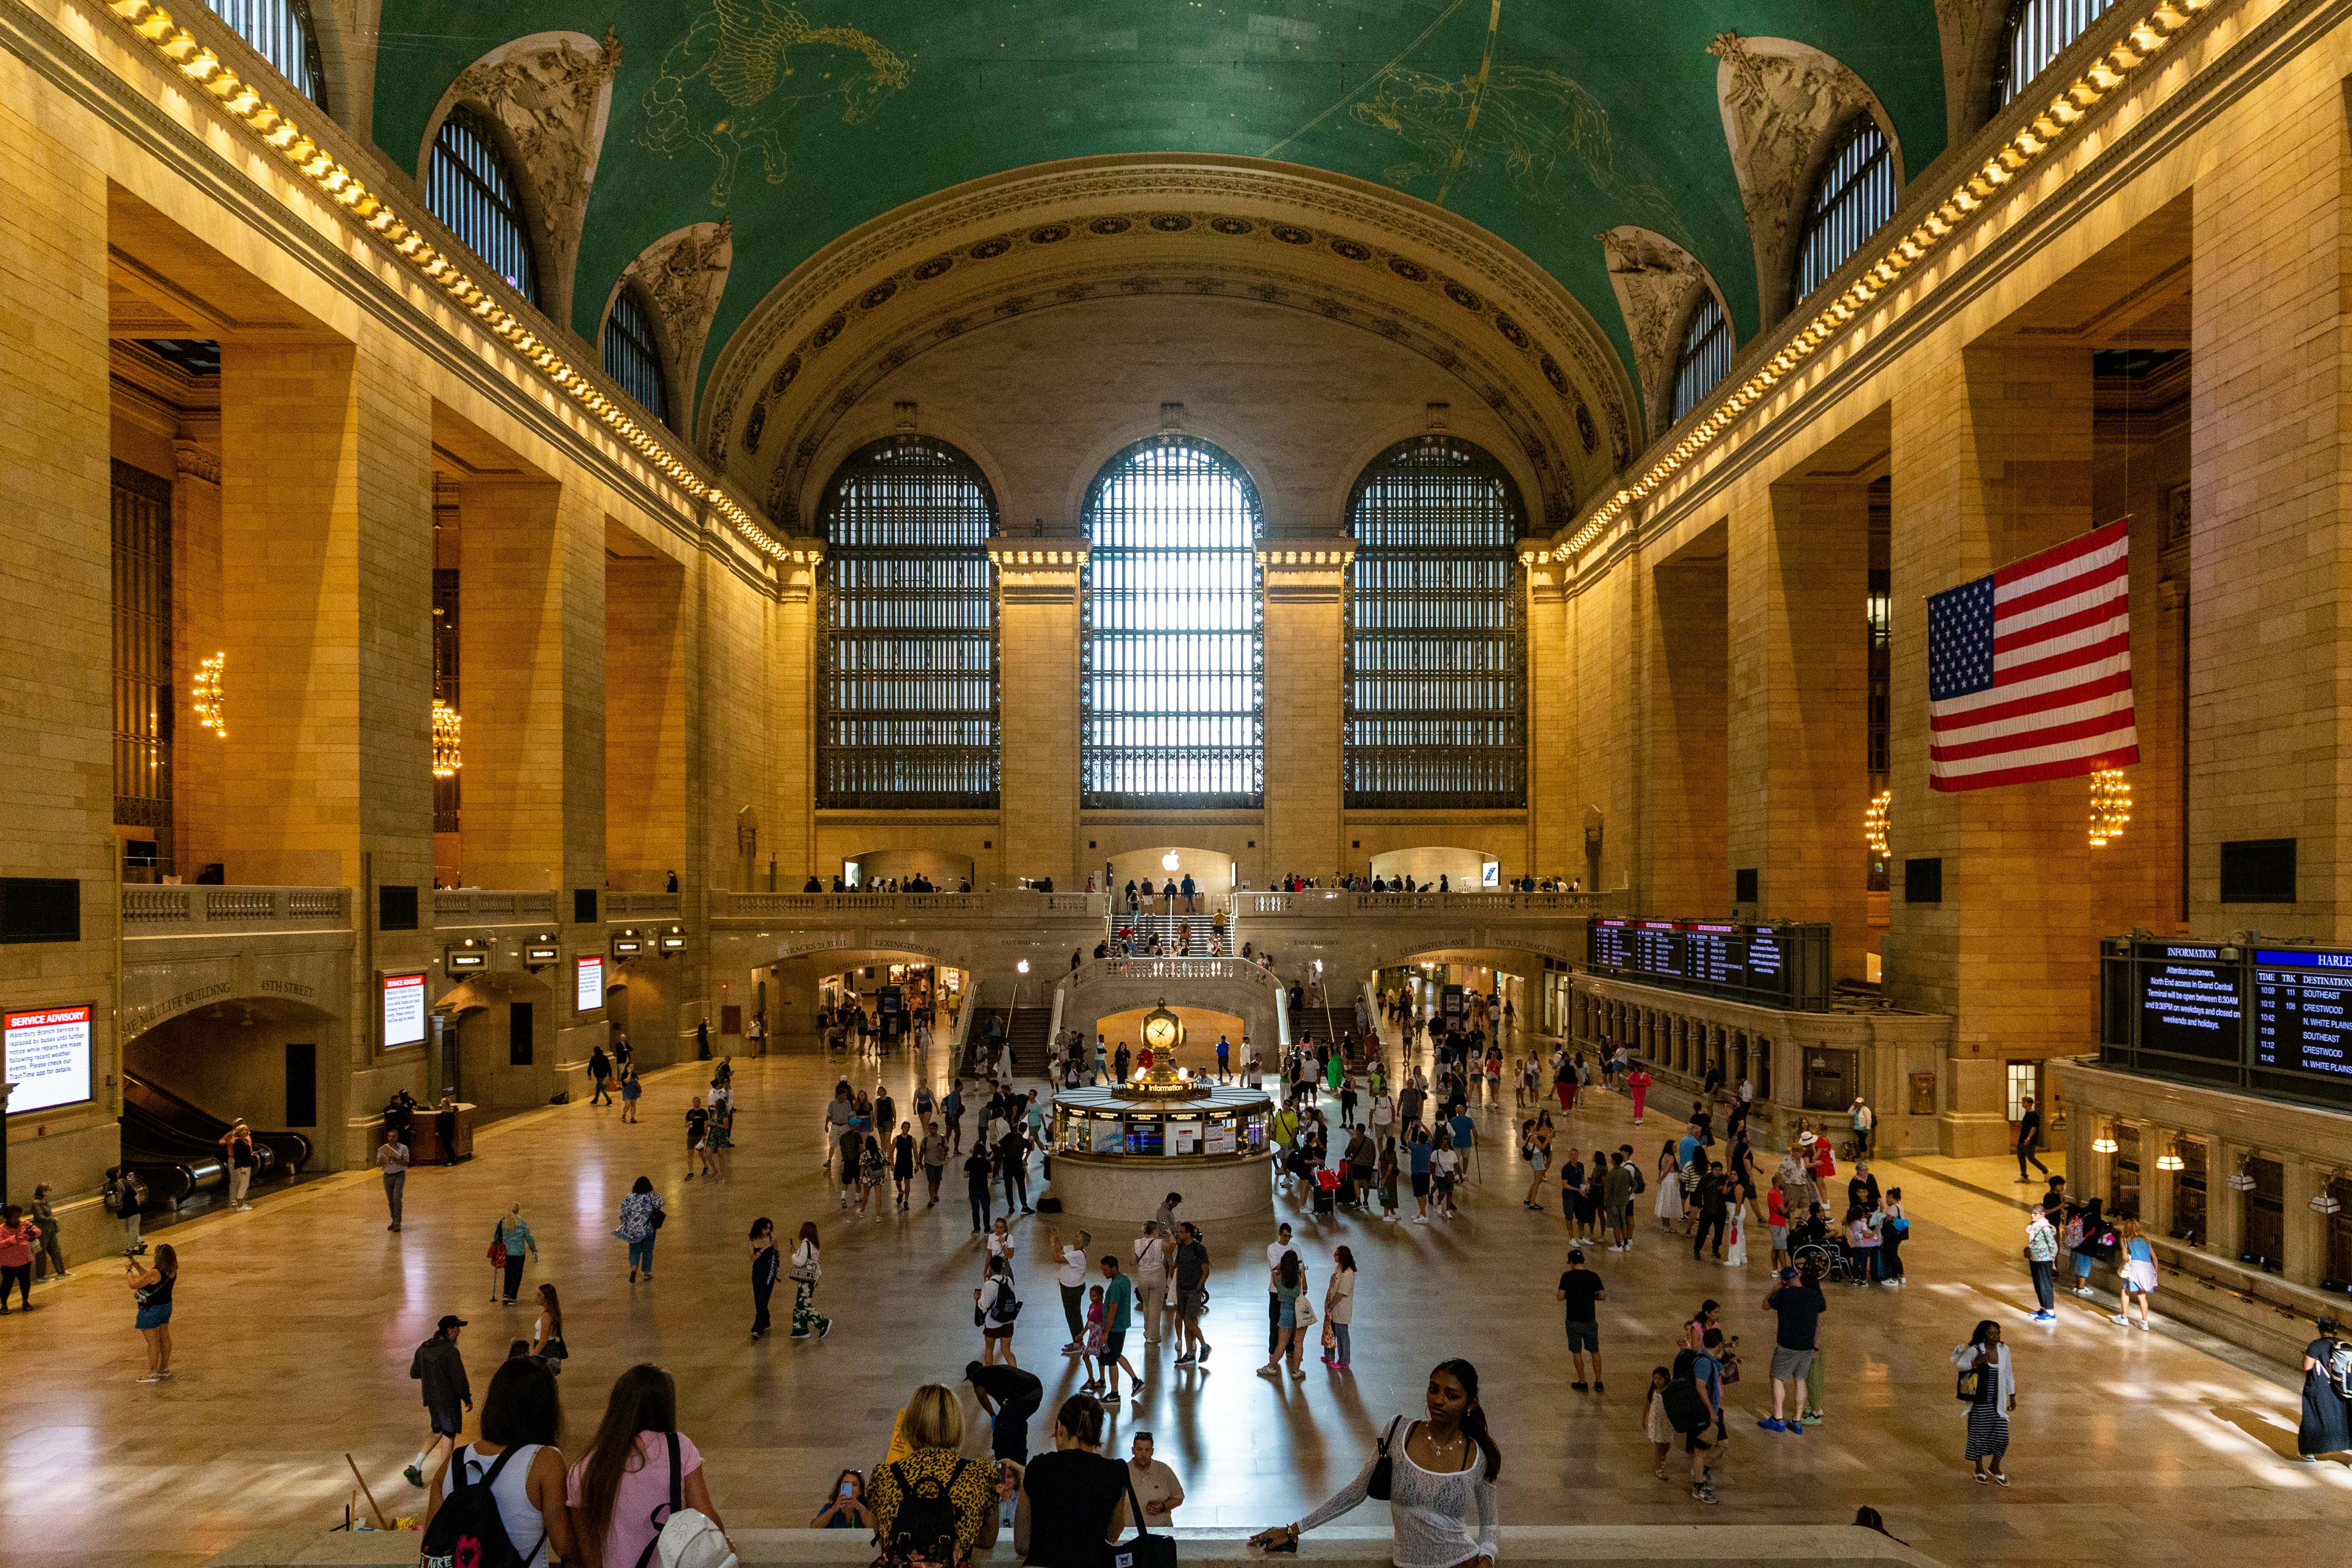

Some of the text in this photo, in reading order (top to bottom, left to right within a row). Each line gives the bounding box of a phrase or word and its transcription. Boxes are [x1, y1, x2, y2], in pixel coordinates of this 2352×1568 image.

[785, 943, 816, 955] TRACKS
[875, 940, 942, 955] LEXINGTON AVE
[1400, 941, 1448, 955] LEXINGTON
[1495, 939, 1567, 956] TICKET MACHINES
[2167, 947, 2216, 958] INFORMATION
[2166, 966, 2215, 978] Attention customers,
[2150, 977, 2164, 985] North
[2198, 981, 2213, 989] Grand
[2214, 982, 2233, 991] Central
[2259, 973, 2352, 987] TIME TRK DESTINATION
[284, 981, 314, 998] STREET
[2147, 989, 2167, 998] Terminal
[2196, 994, 2217, 1002] between
[2218, 995, 2238, 1004] 6:30AM
[2303, 990, 2340, 1000] SOUTHEAST
[139, 995, 184, 1026] METLIFE
[184, 982, 230, 1005] BUILDING
[2155, 1002, 2172, 1010] 9:30PM
[2180, 1005, 2204, 1015] weekdays
[2216, 1009, 2233, 1017] closed
[2260, 1000, 2275, 1008] 10:12
[2303, 1004, 2343, 1014] CRESTWOOD
[11, 1011, 84, 1027] SERVICE ADVISORY
[2162, 1016, 2187, 1025] weekends
[2198, 1019, 2220, 1029] holidays.
[2311, 1019, 2330, 1027] WHITE
[2331, 1021, 2352, 1030] PLAINS
[2303, 1032, 2340, 1043] SOUTHEAST
[2260, 1041, 2343, 1058] 11:12 CRESTWOOD
[2260, 1054, 2274, 1063] 11:42
[2310, 1060, 2329, 1071] WHITE
[2331, 1063, 2352, 1074] PLAINS
